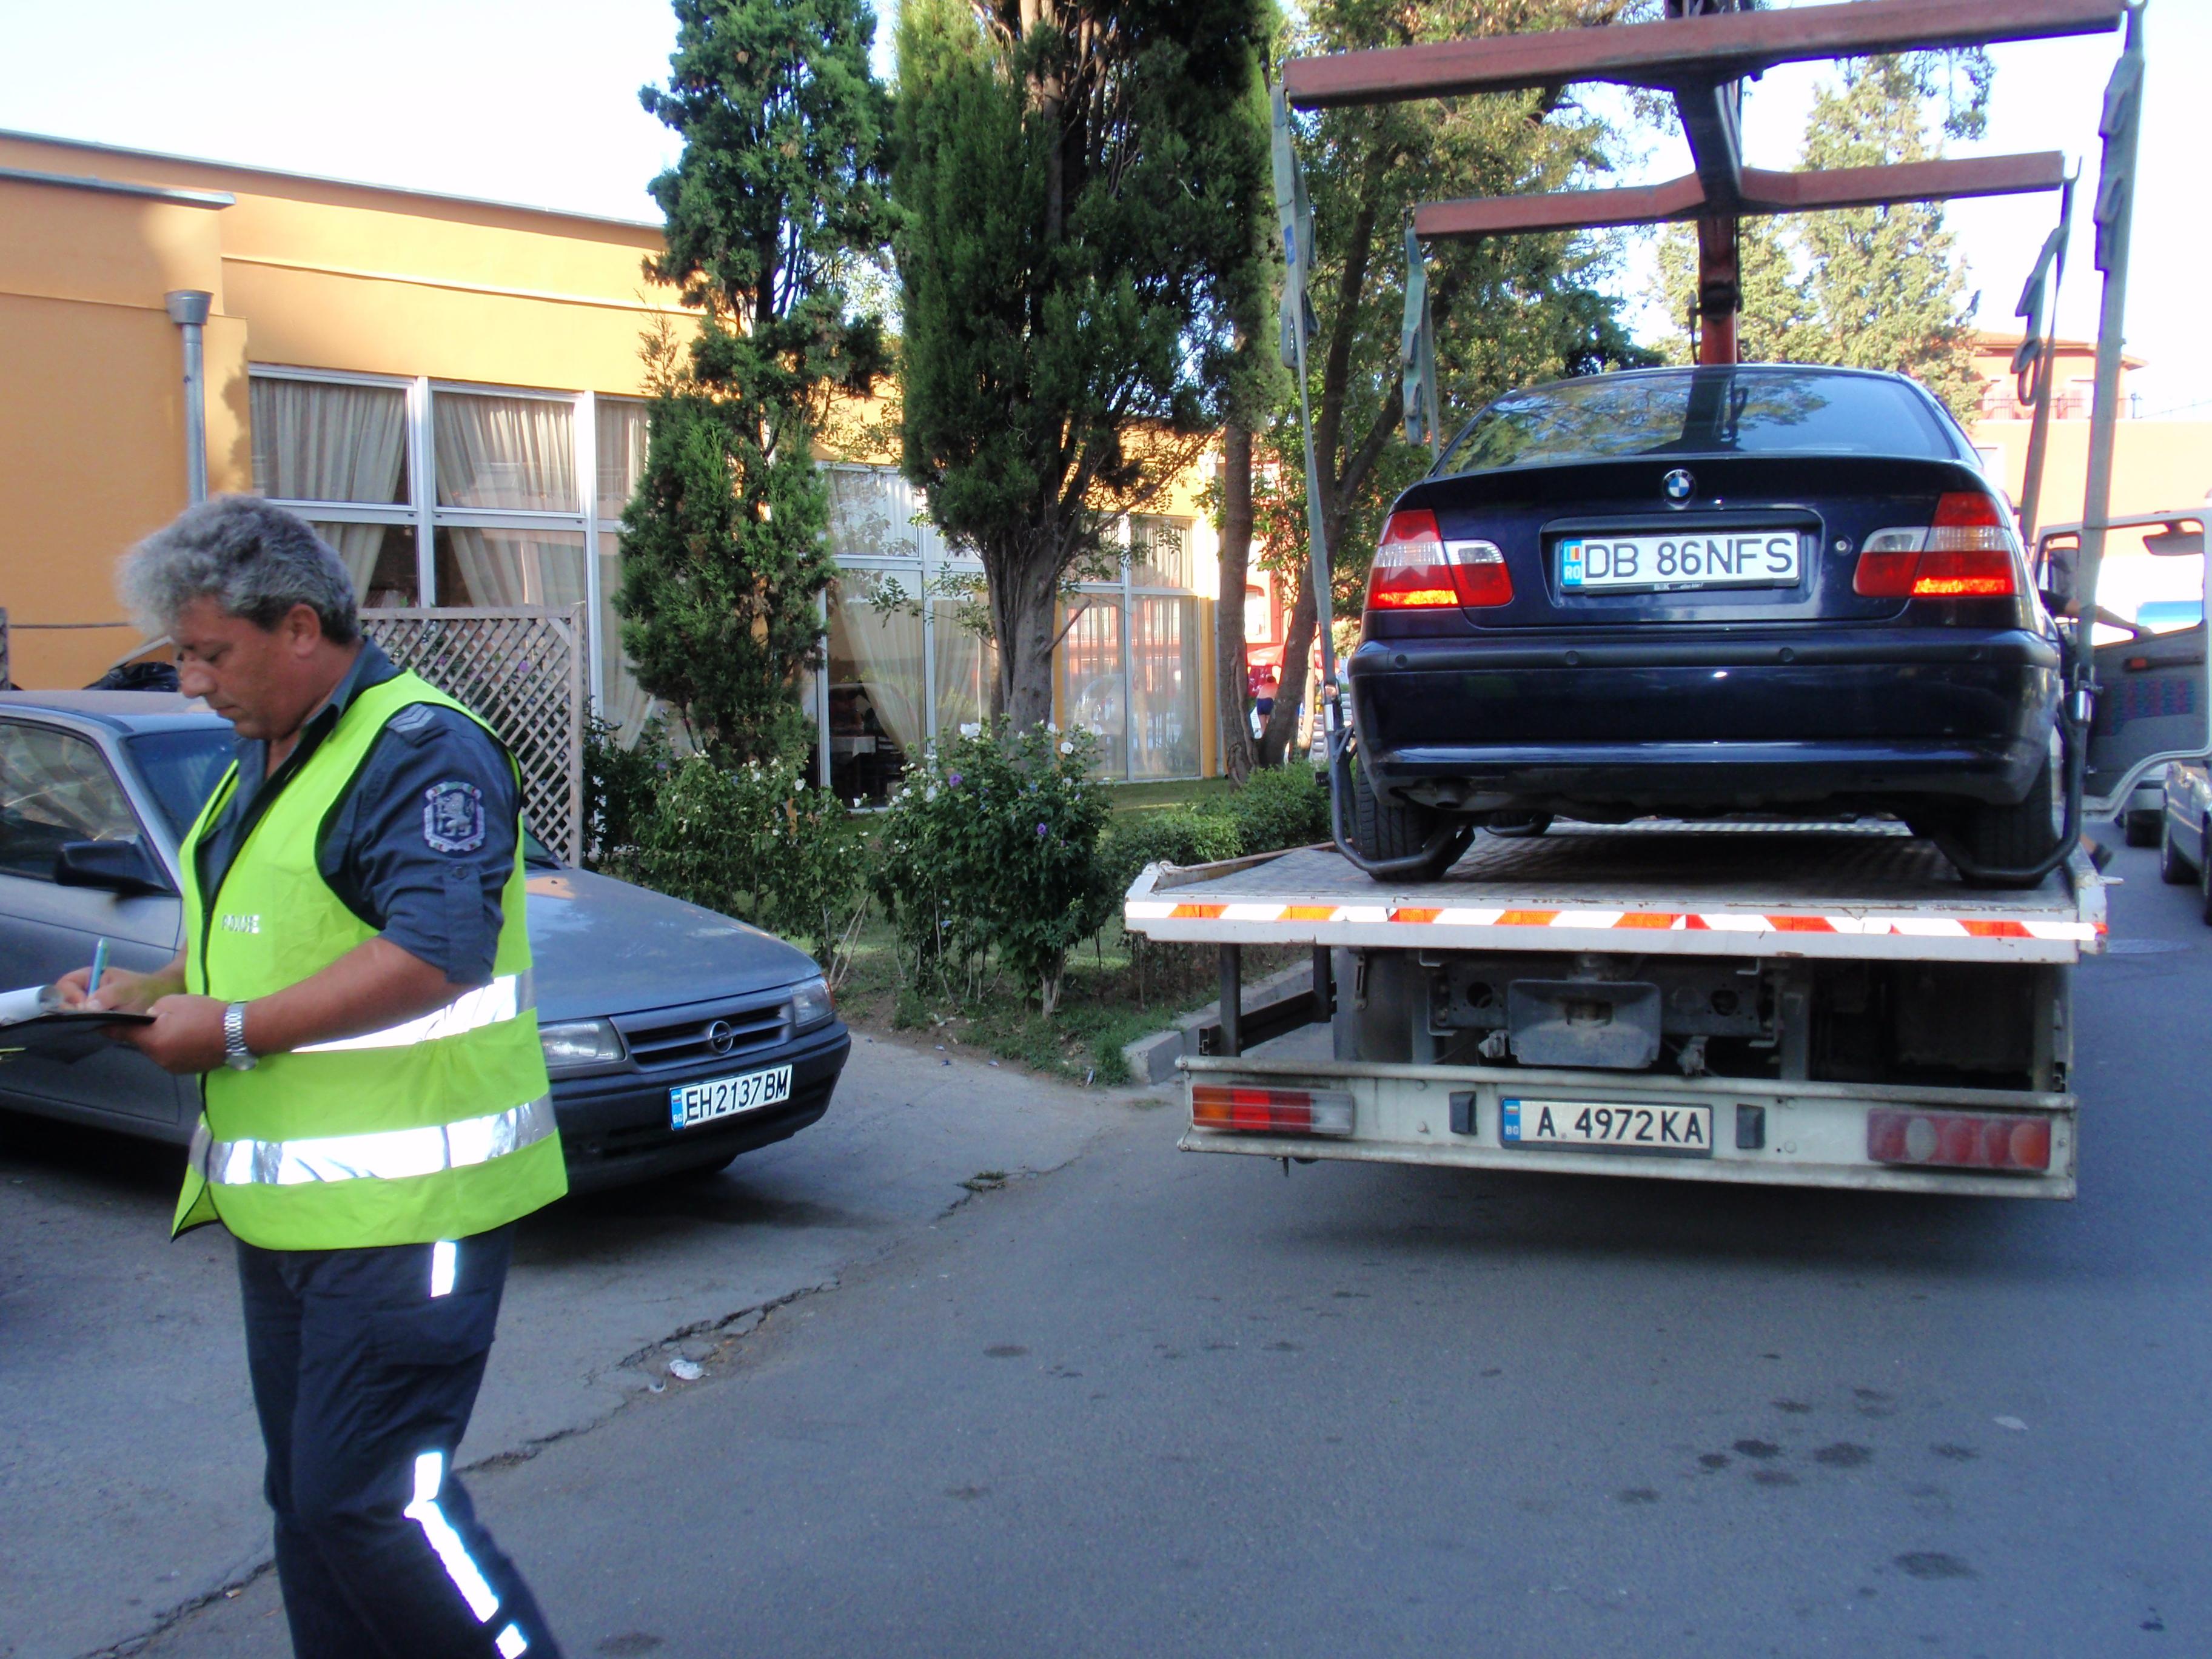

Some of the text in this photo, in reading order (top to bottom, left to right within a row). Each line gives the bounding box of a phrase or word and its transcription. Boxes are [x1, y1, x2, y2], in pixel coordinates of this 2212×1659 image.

[1585, 537, 1792, 578] DB 86NFS
[1564, 565, 1581, 580] RO
[1506, 1125, 1520, 1136] BG
